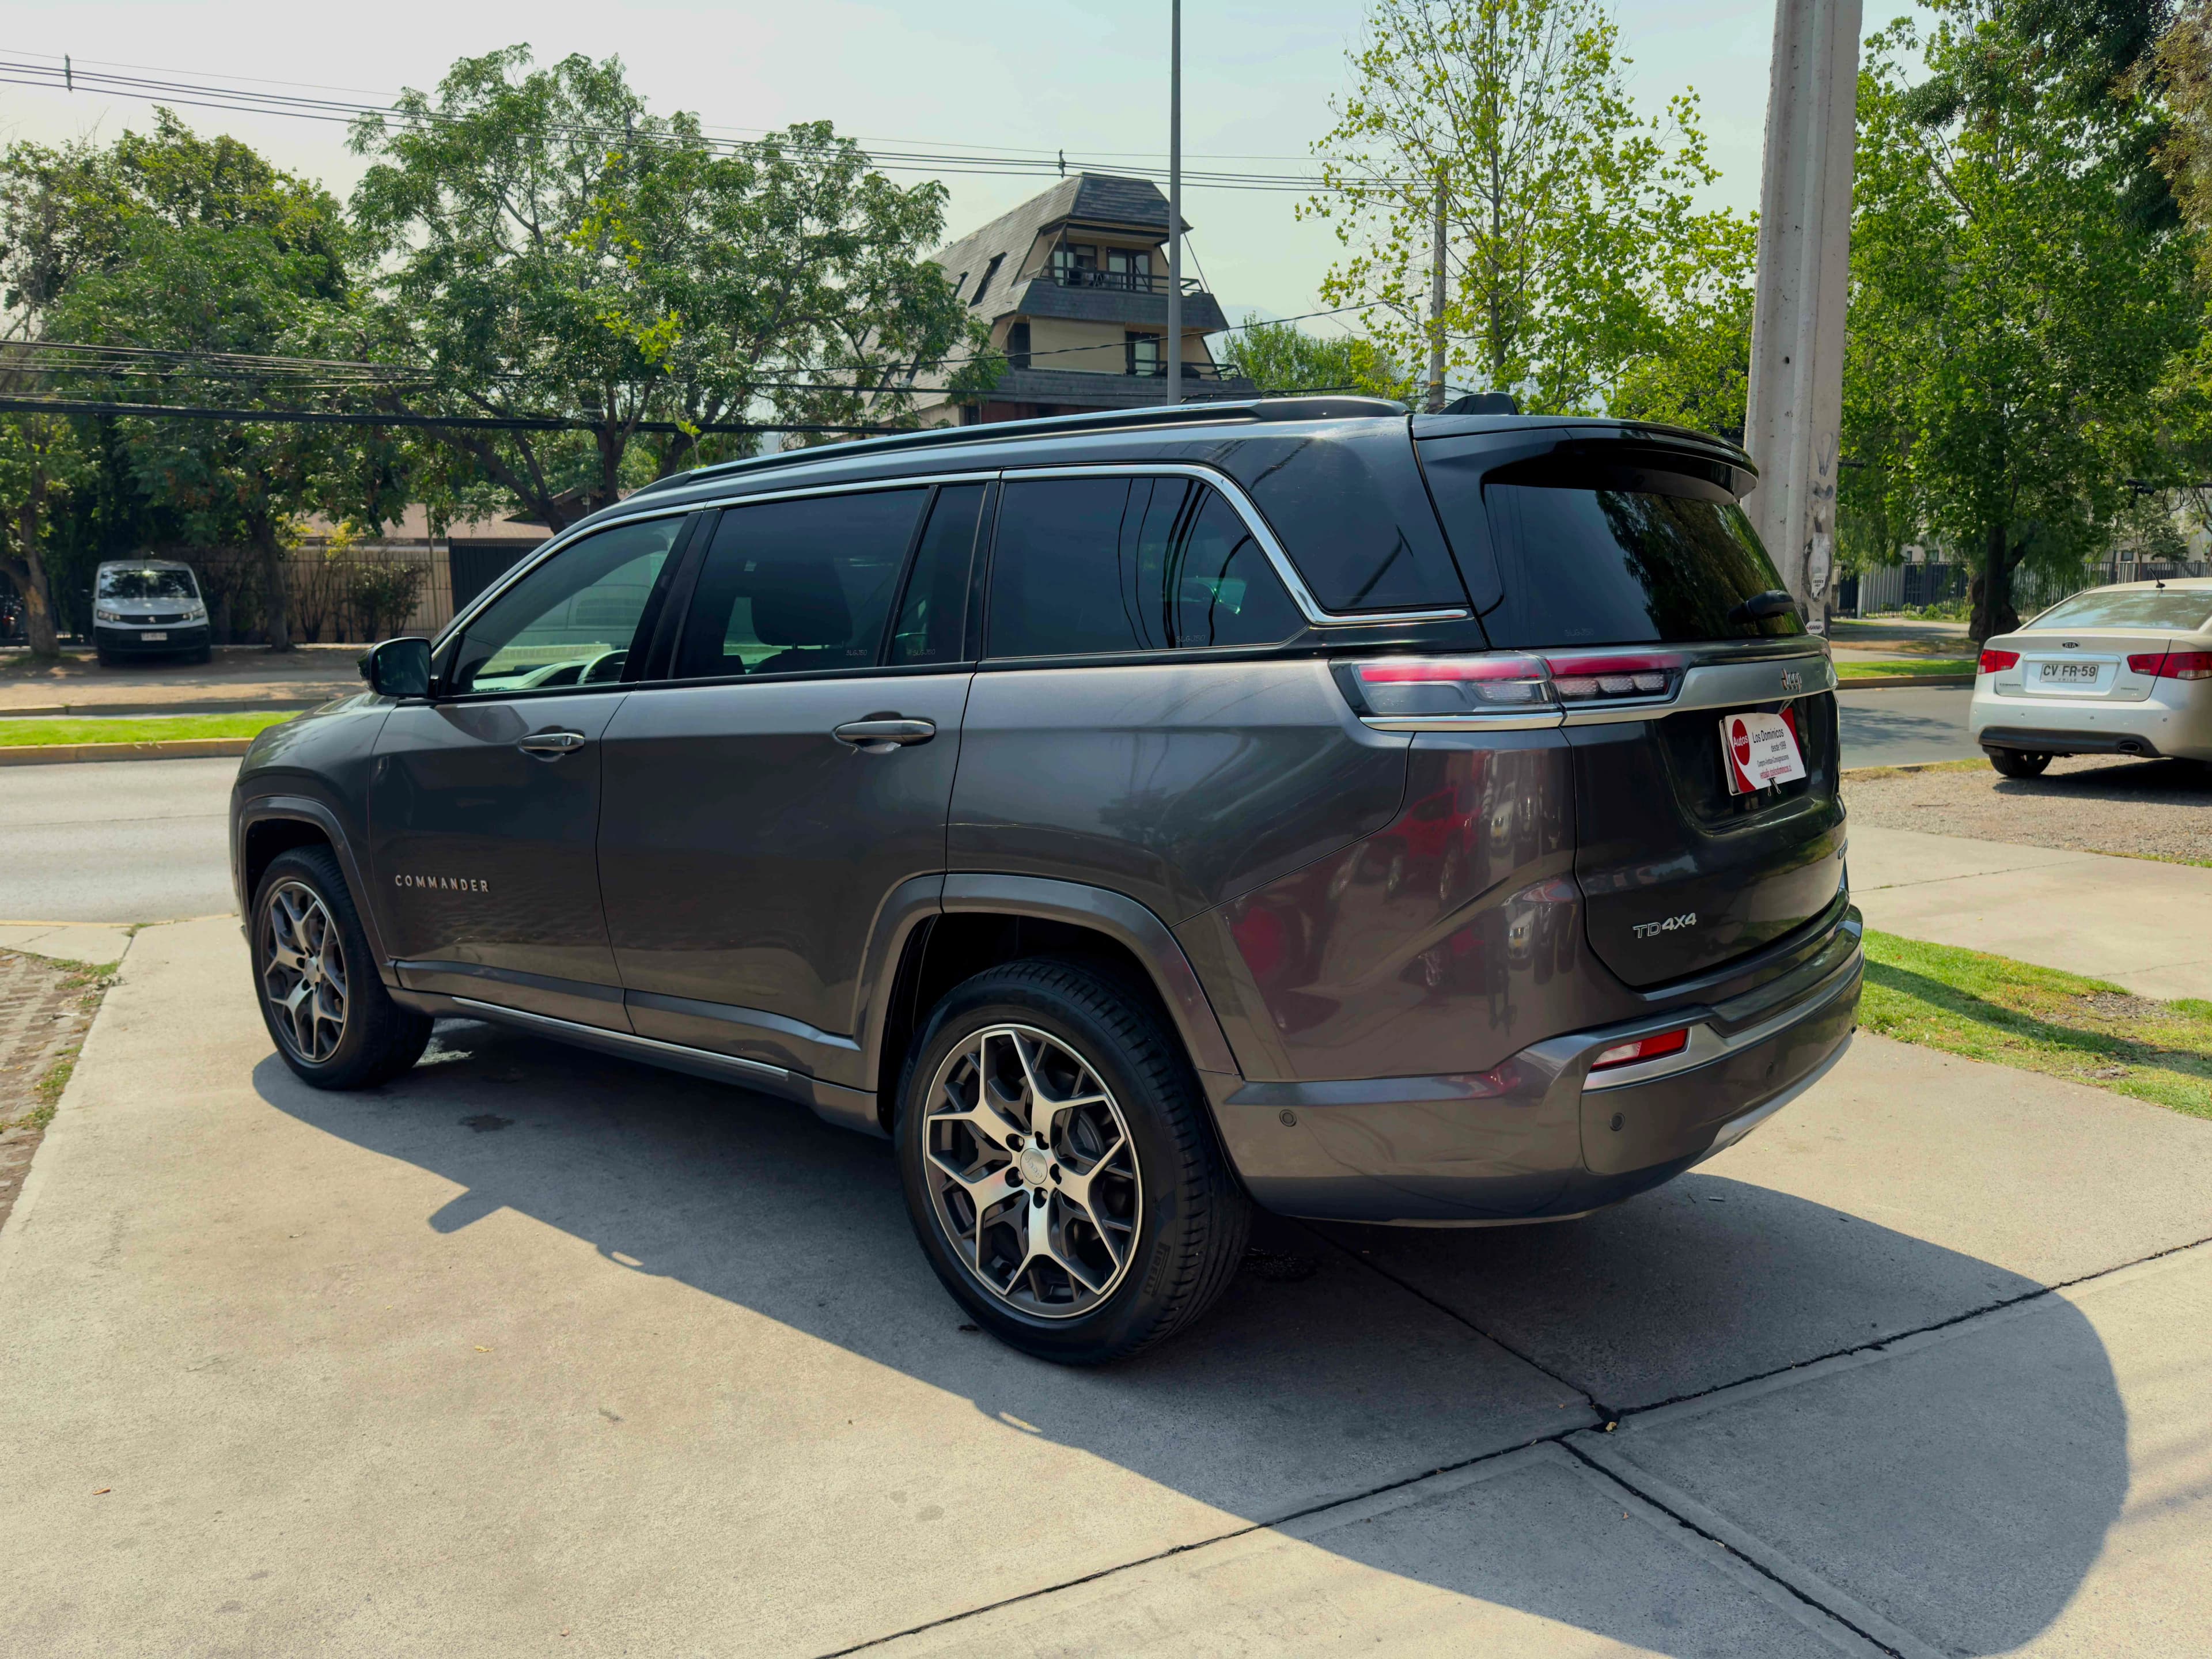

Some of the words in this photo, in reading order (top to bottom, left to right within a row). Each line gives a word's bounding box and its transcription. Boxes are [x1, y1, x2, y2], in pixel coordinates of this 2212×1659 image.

[1733, 735, 1748, 748] Autos
[1752, 732, 1761, 744] Los
[1760, 728, 1785, 742] Dominicos
[395, 874, 489, 892] COMMANDER
